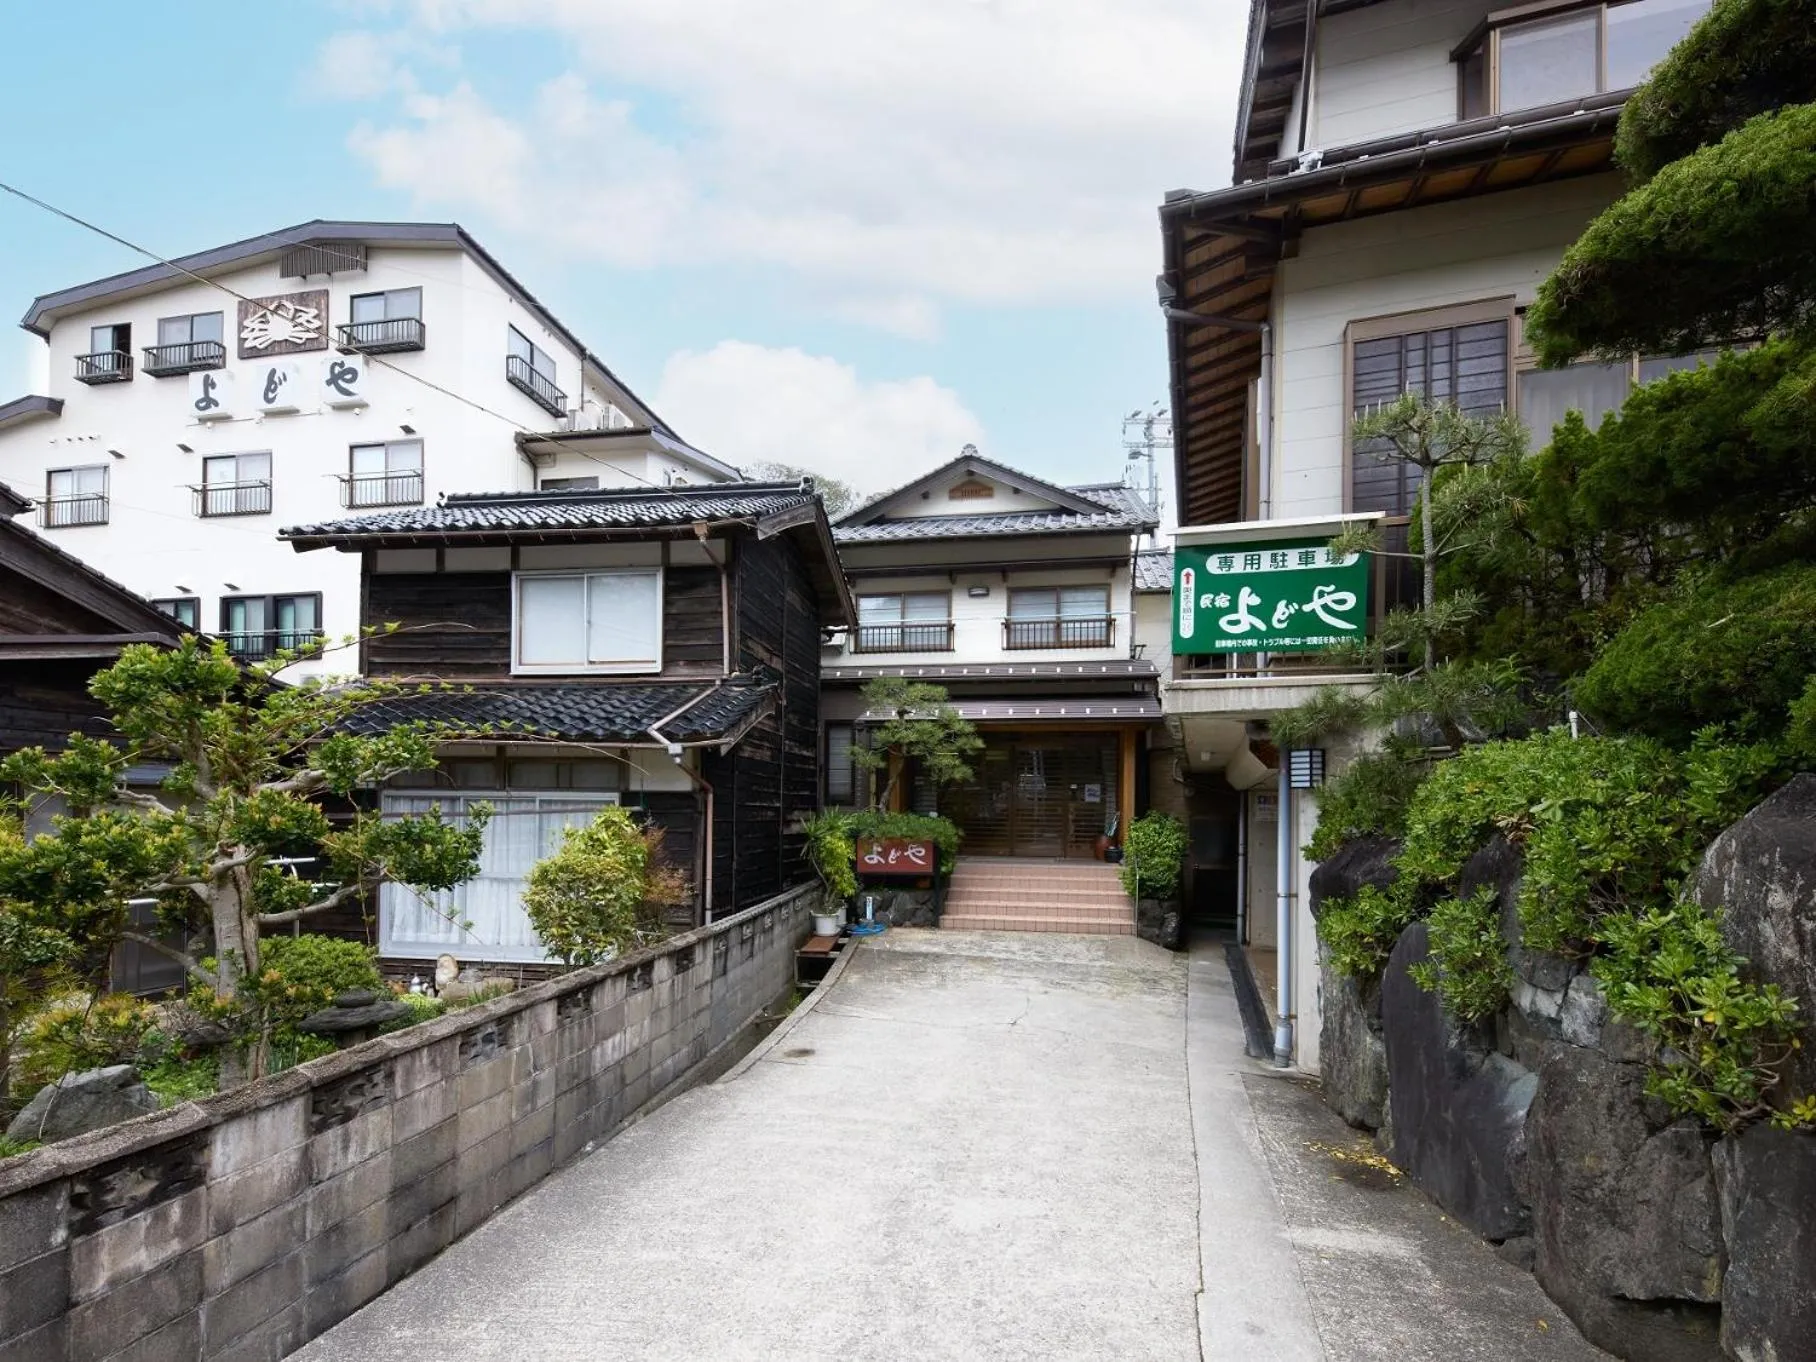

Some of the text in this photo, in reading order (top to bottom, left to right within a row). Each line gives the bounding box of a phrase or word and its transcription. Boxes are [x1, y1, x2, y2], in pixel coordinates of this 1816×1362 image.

[195, 360, 359, 411] よどや
[1217, 549, 1345, 572] 専用駐車場
[1218, 584, 1358, 634] よどや
[864, 843, 927, 865] よどや
